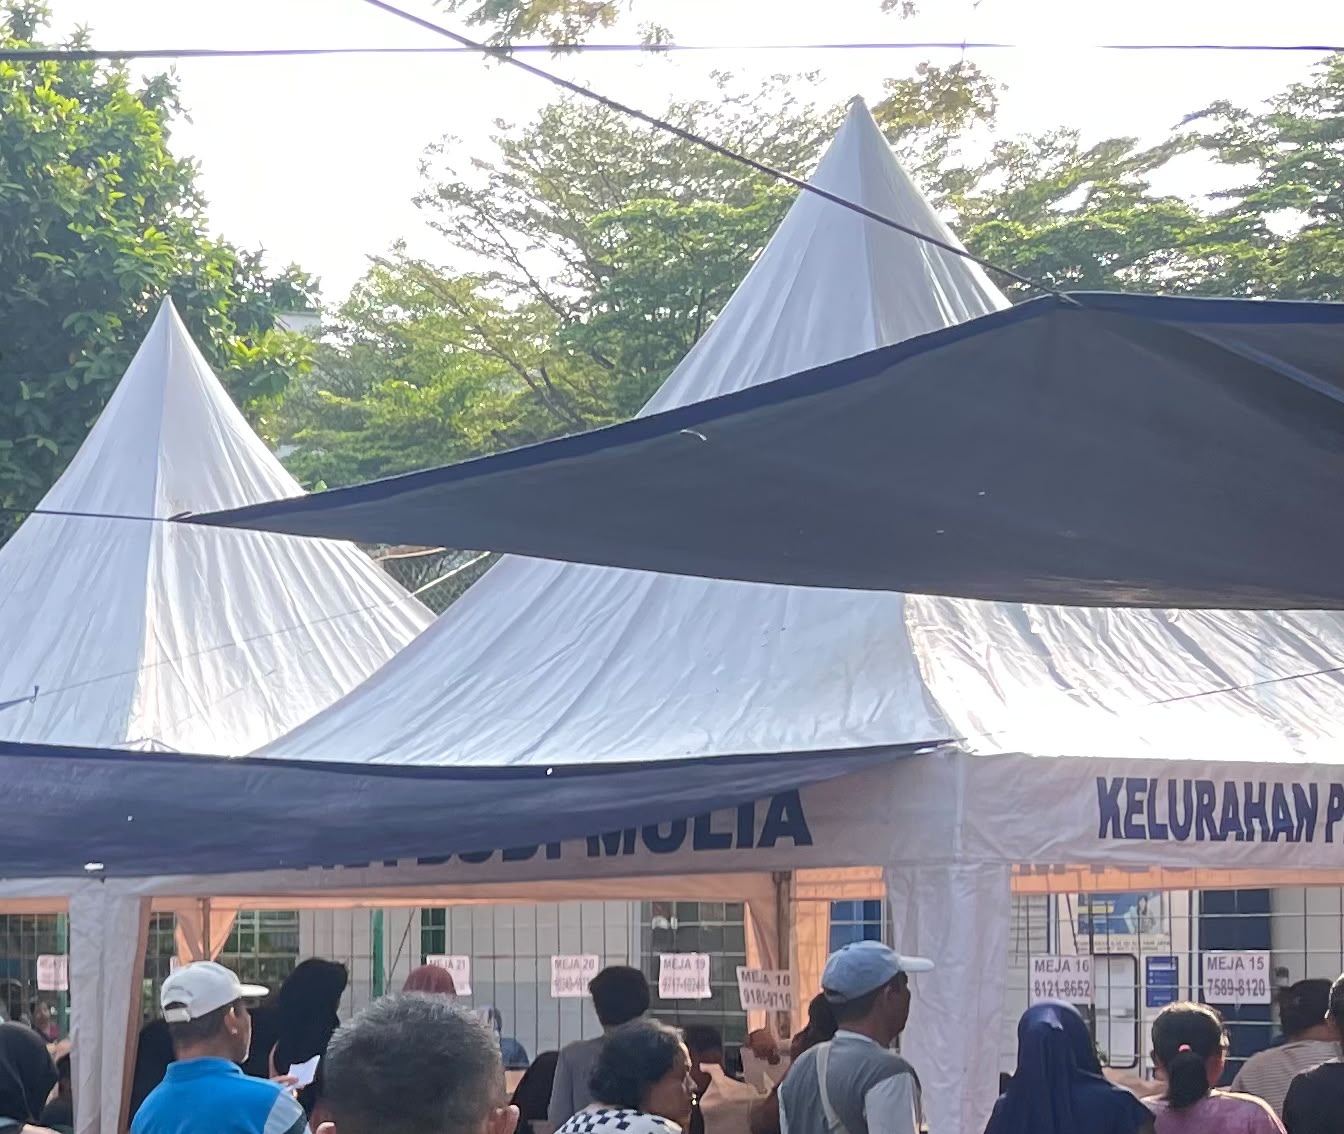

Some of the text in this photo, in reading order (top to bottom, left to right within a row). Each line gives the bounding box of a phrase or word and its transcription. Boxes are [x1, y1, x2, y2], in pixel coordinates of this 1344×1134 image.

[1096, 776, 1344, 843] KELURAHAN P
[554, 958, 580, 970] MEJA
[663, 958, 692, 970] MEJA
[1034, 958, 1090, 973] MEJA 16
[1208, 956, 1265, 971] MEJA 15
[1034, 980, 1091, 998] 8121-8652
[1207, 978, 1266, 997] 7589-8120
